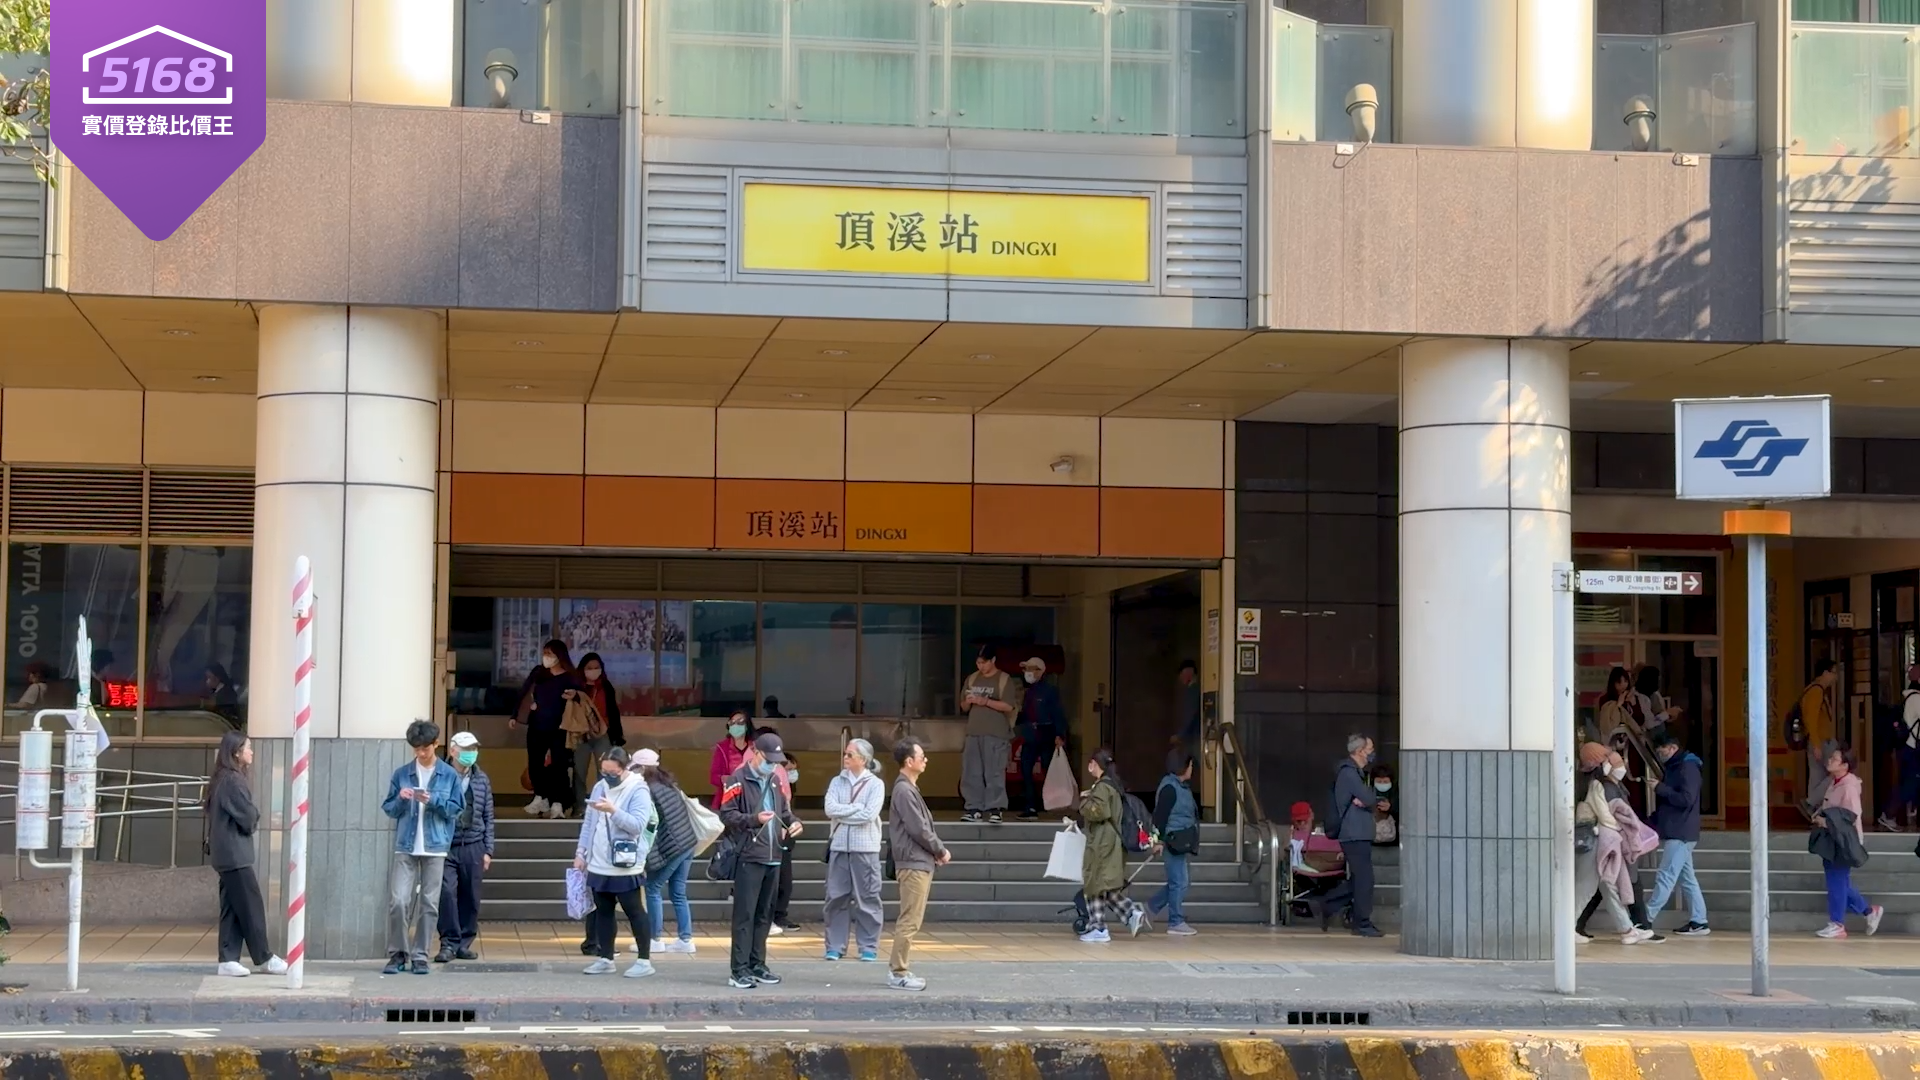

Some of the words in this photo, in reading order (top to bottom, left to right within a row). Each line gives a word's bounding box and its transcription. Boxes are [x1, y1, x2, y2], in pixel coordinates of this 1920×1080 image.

[834, 211, 979, 255] 頂溪站
[991, 241, 1057, 257] DINGXI
[746, 510, 839, 540] 頂溪站
[855, 528, 908, 541] DINGXI
[1585, 578, 1604, 586] 125m
